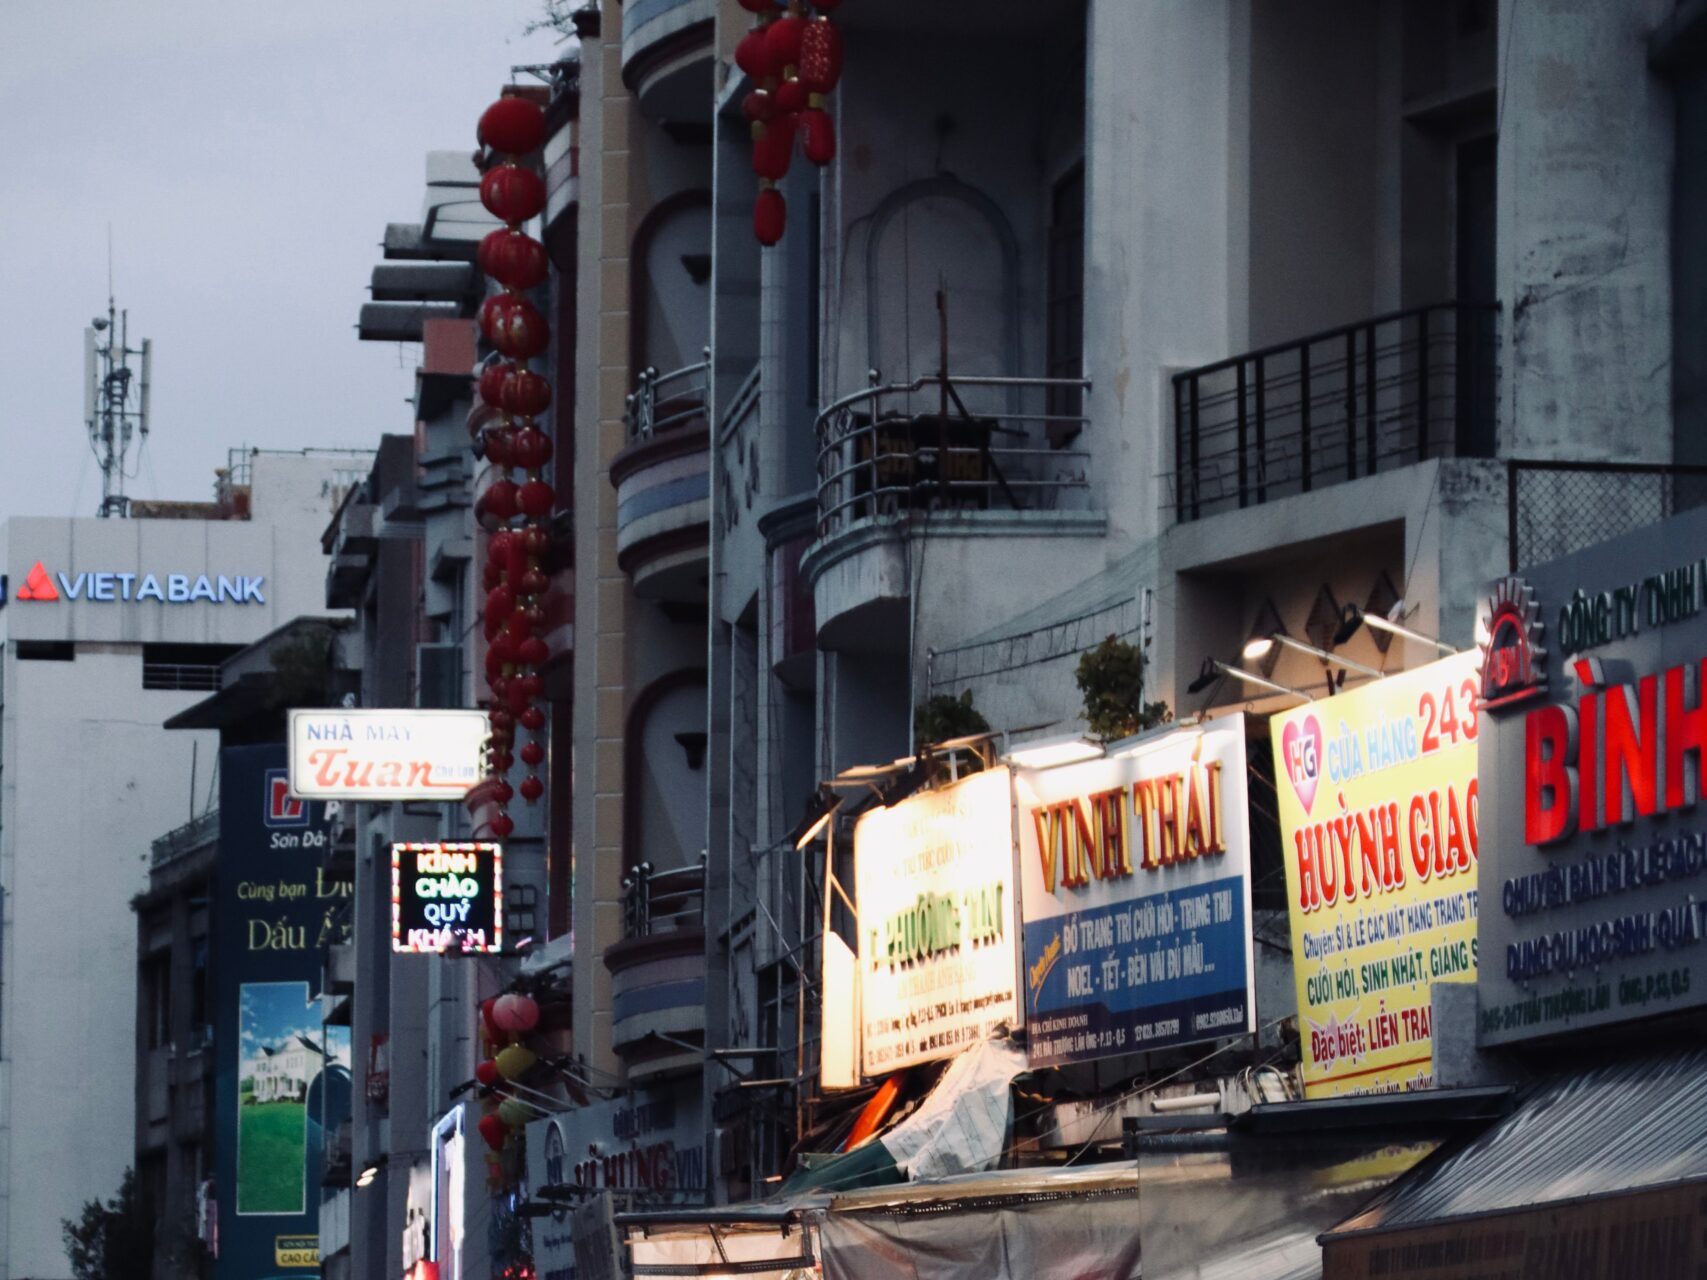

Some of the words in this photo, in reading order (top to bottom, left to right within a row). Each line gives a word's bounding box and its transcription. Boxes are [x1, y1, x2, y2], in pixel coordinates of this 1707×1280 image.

[58, 572, 265, 604] VIETABANK
[1644, 560, 1700, 627] TNHH
[307, 719, 353, 741] NHÀ
[1419, 678, 1478, 754] 243
[1290, 737, 1318, 784] HG
[1524, 657, 1707, 846] BÌNH
[1133, 736, 1227, 870] THÁI
[1294, 791, 1404, 909] HUỲNH
[237, 881, 275, 901] Cùng
[279, 880, 306, 900] bạn
[415, 873, 479, 898] CHÀO
[248, 915, 305, 950] Dấu
[424, 898, 471, 926] QUÝ
[1080, 915, 1114, 951] TRANG
[1179, 894, 1211, 931] TRUNG
[1214, 889, 1233, 923] THU
[1407, 898, 1433, 933] HÀNG
[1434, 893, 1466, 924] TRANG
[1466, 890, 1478, 919] TR
[408, 923, 486, 947] KHÁH
[1067, 965, 1094, 999] NOEL
[1101, 950, 1120, 992] TẾT
[1361, 959, 1389, 994] SINH
[1429, 936, 1469, 978] GIÁNG
[1401, 1005, 1432, 1043] TRA
[303, 1250, 319, 1263] CẤ
